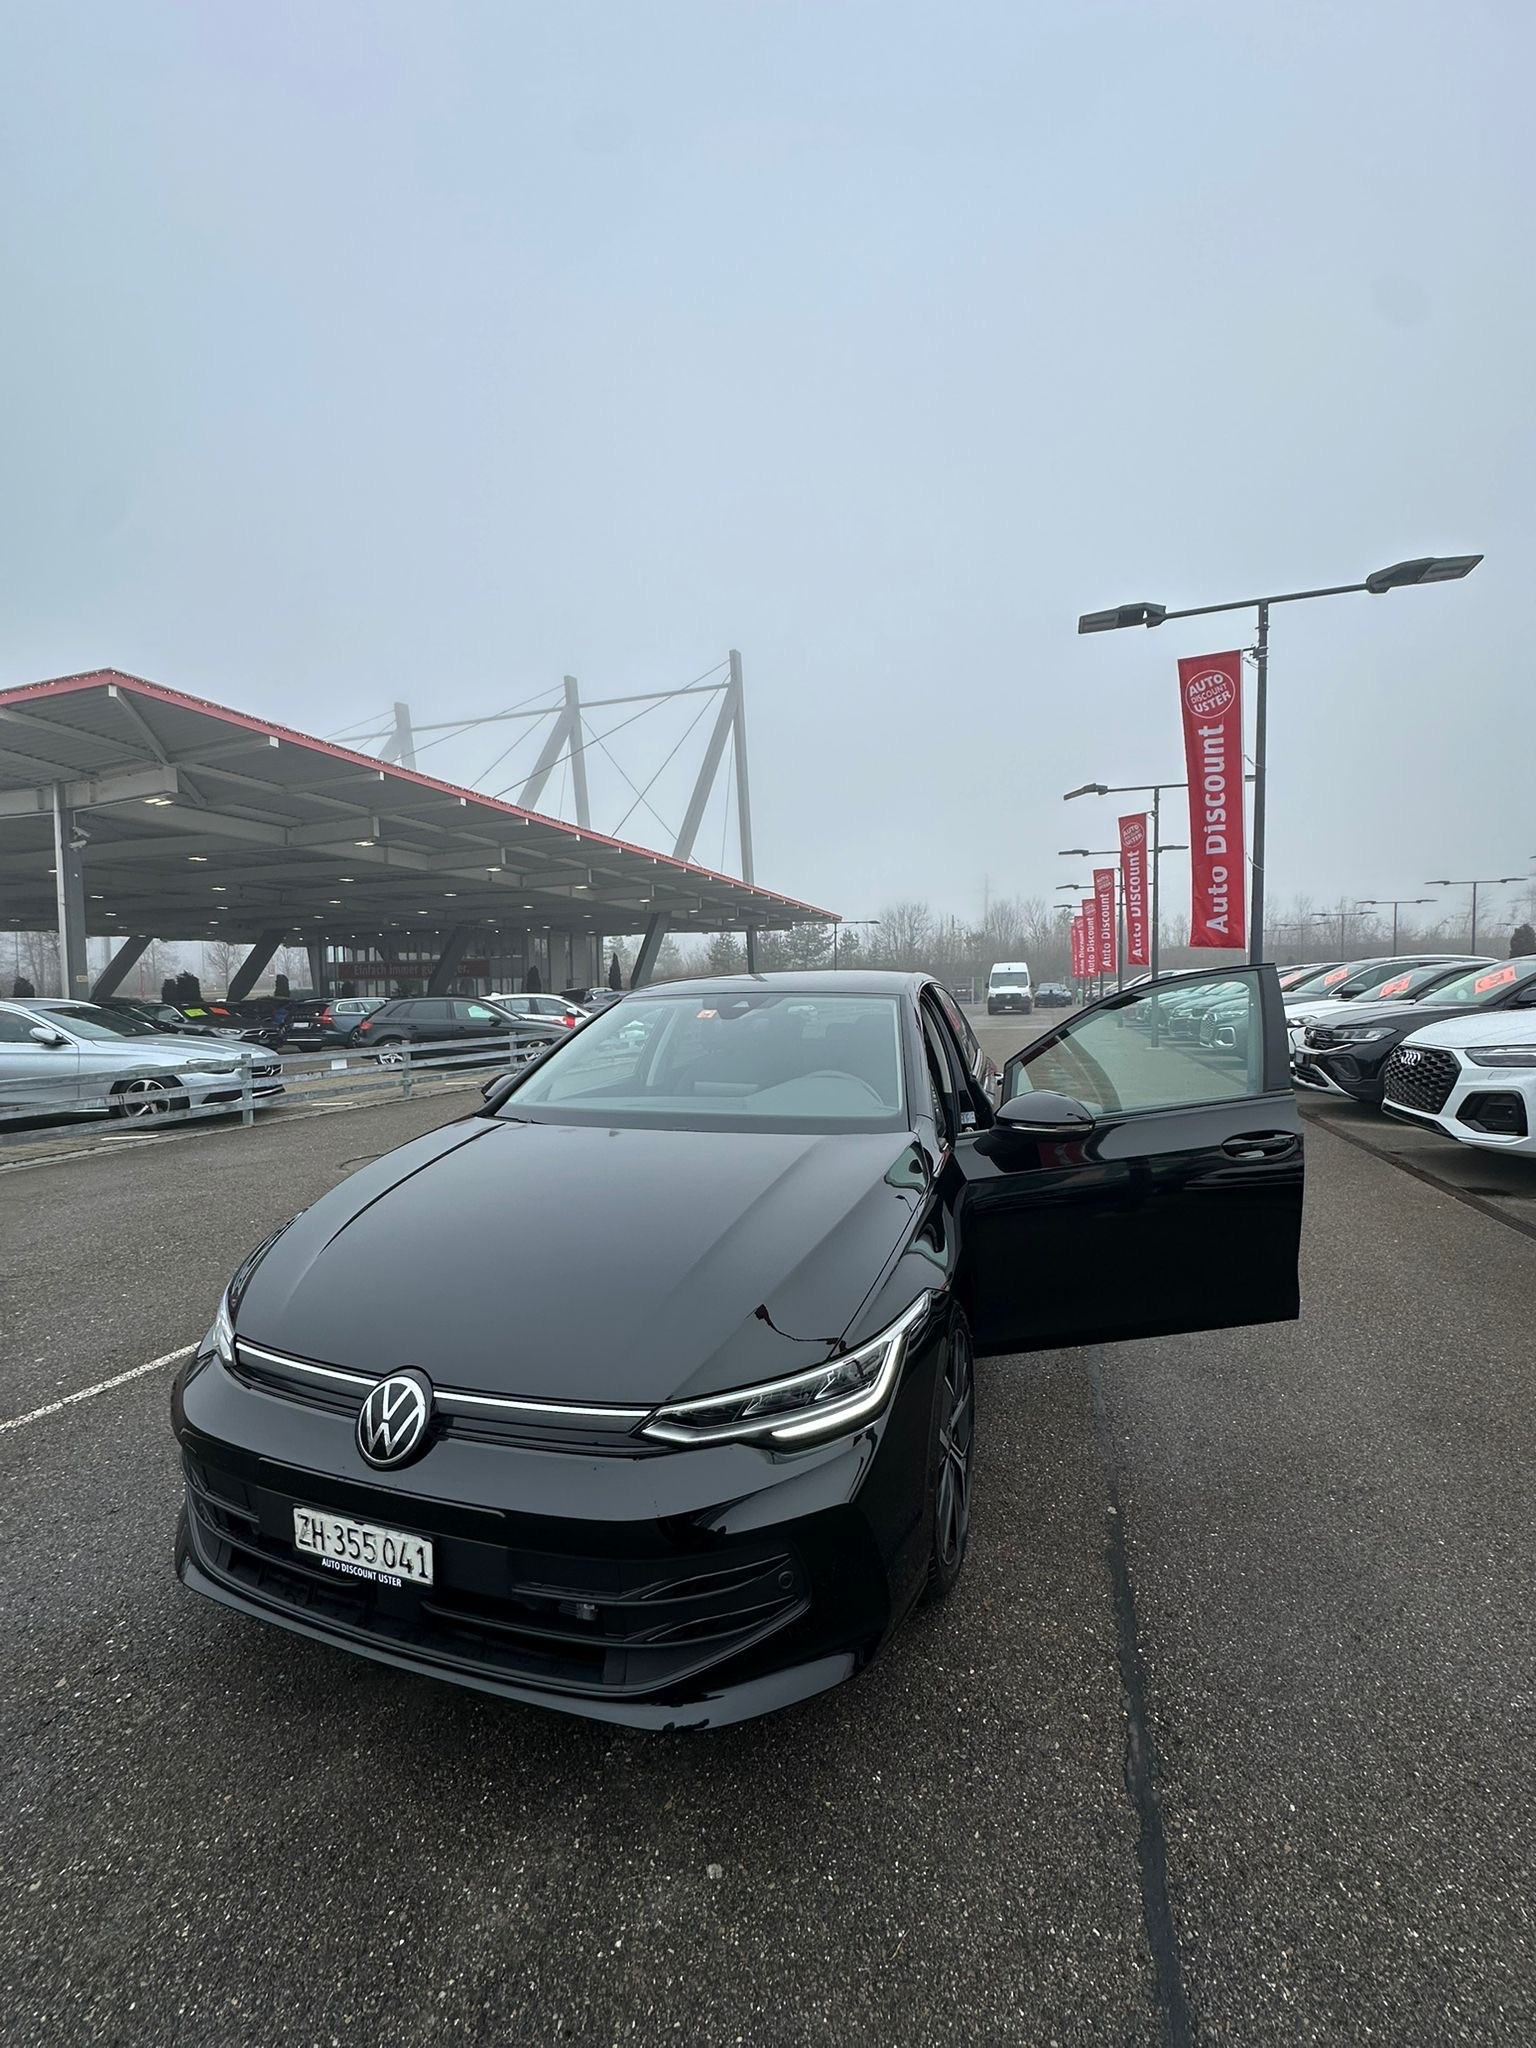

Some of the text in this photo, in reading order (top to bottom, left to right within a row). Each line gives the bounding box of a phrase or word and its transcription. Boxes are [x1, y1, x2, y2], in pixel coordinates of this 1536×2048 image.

[1189, 674, 1224, 697] AUTO
[1191, 682, 1228, 704] DISCOUNT
[1194, 690, 1232, 713] USTER
[1198, 724, 1229, 934] Auto Discount
[1100, 893, 1111, 940] Discount
[1087, 917, 1095, 952] Discount
[1102, 942, 1112, 967] Auto
[354, 963, 386, 976] Einfach
[389, 963, 418, 976] immer
[321, 1558, 402, 1587] AUTO DISCOUNT USTER
